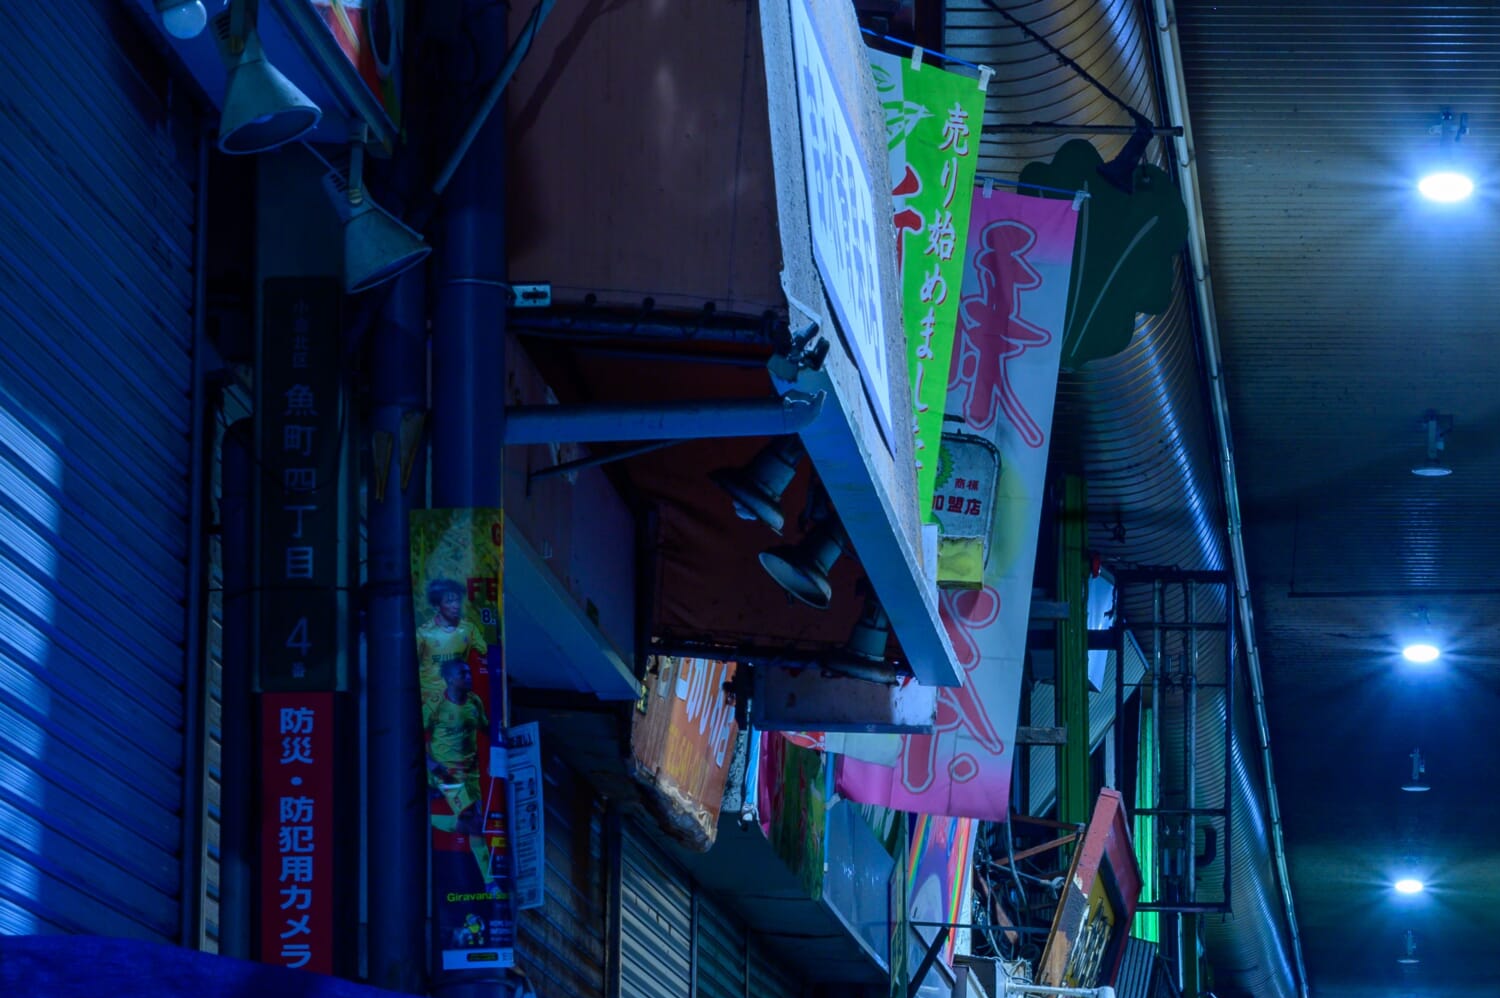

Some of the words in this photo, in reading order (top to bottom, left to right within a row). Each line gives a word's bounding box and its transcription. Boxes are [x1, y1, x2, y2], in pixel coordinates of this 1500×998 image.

[912, 101, 970, 468] 売り始めまし
[281, 384, 319, 581] 魚町四丁目
[278, 706, 316, 969] 防災・防犯用カメラ
